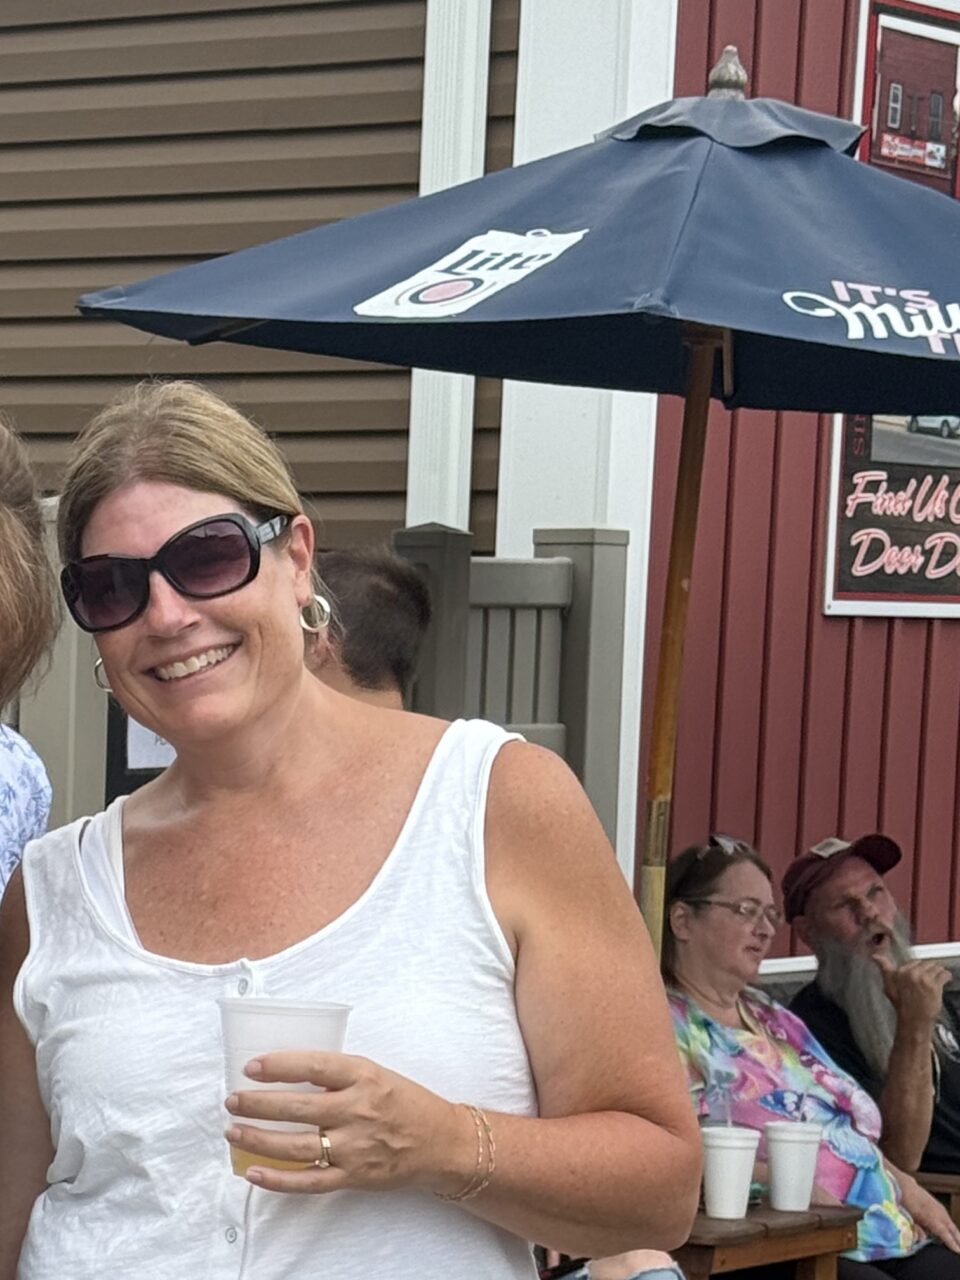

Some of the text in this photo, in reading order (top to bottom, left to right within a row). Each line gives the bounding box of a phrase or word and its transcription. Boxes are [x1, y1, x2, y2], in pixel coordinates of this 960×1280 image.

[435, 249, 553, 276] Lite
[831, 279, 937, 310] IT'S
[782, 290, 960, 340] Mill
[845, 470, 917, 518] Find
[913, 474, 950, 523] Us
